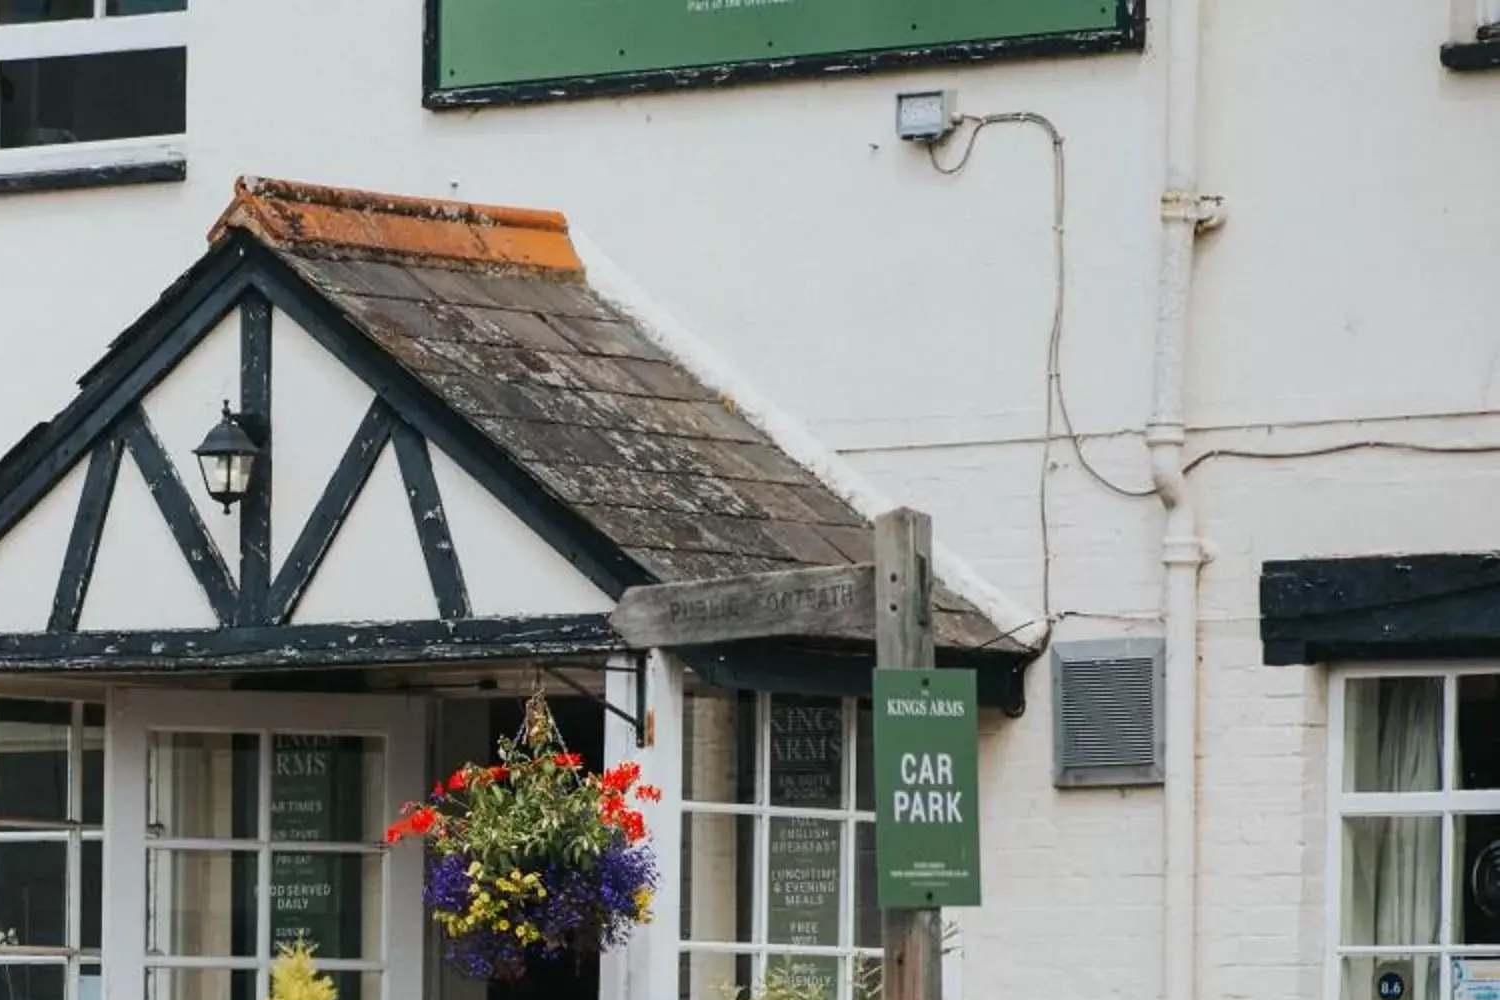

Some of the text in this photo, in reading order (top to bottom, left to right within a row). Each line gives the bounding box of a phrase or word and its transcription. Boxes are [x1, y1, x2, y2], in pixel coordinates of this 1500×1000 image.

[669, 594, 740, 623] PUBLIC
[887, 698, 965, 717] KINGS ARMS
[268, 752, 326, 777] RMS
[901, 752, 953, 785] CAR
[893, 790, 963, 823] PARK
[771, 841, 837, 854] BREAKFAST
[287, 884, 331, 897] SERVED
[785, 881, 836, 894] EVENING
[276, 898, 309, 910] DAILY
[785, 894, 824, 906] MEALS
[1380, 982, 1402, 994] 8.6
